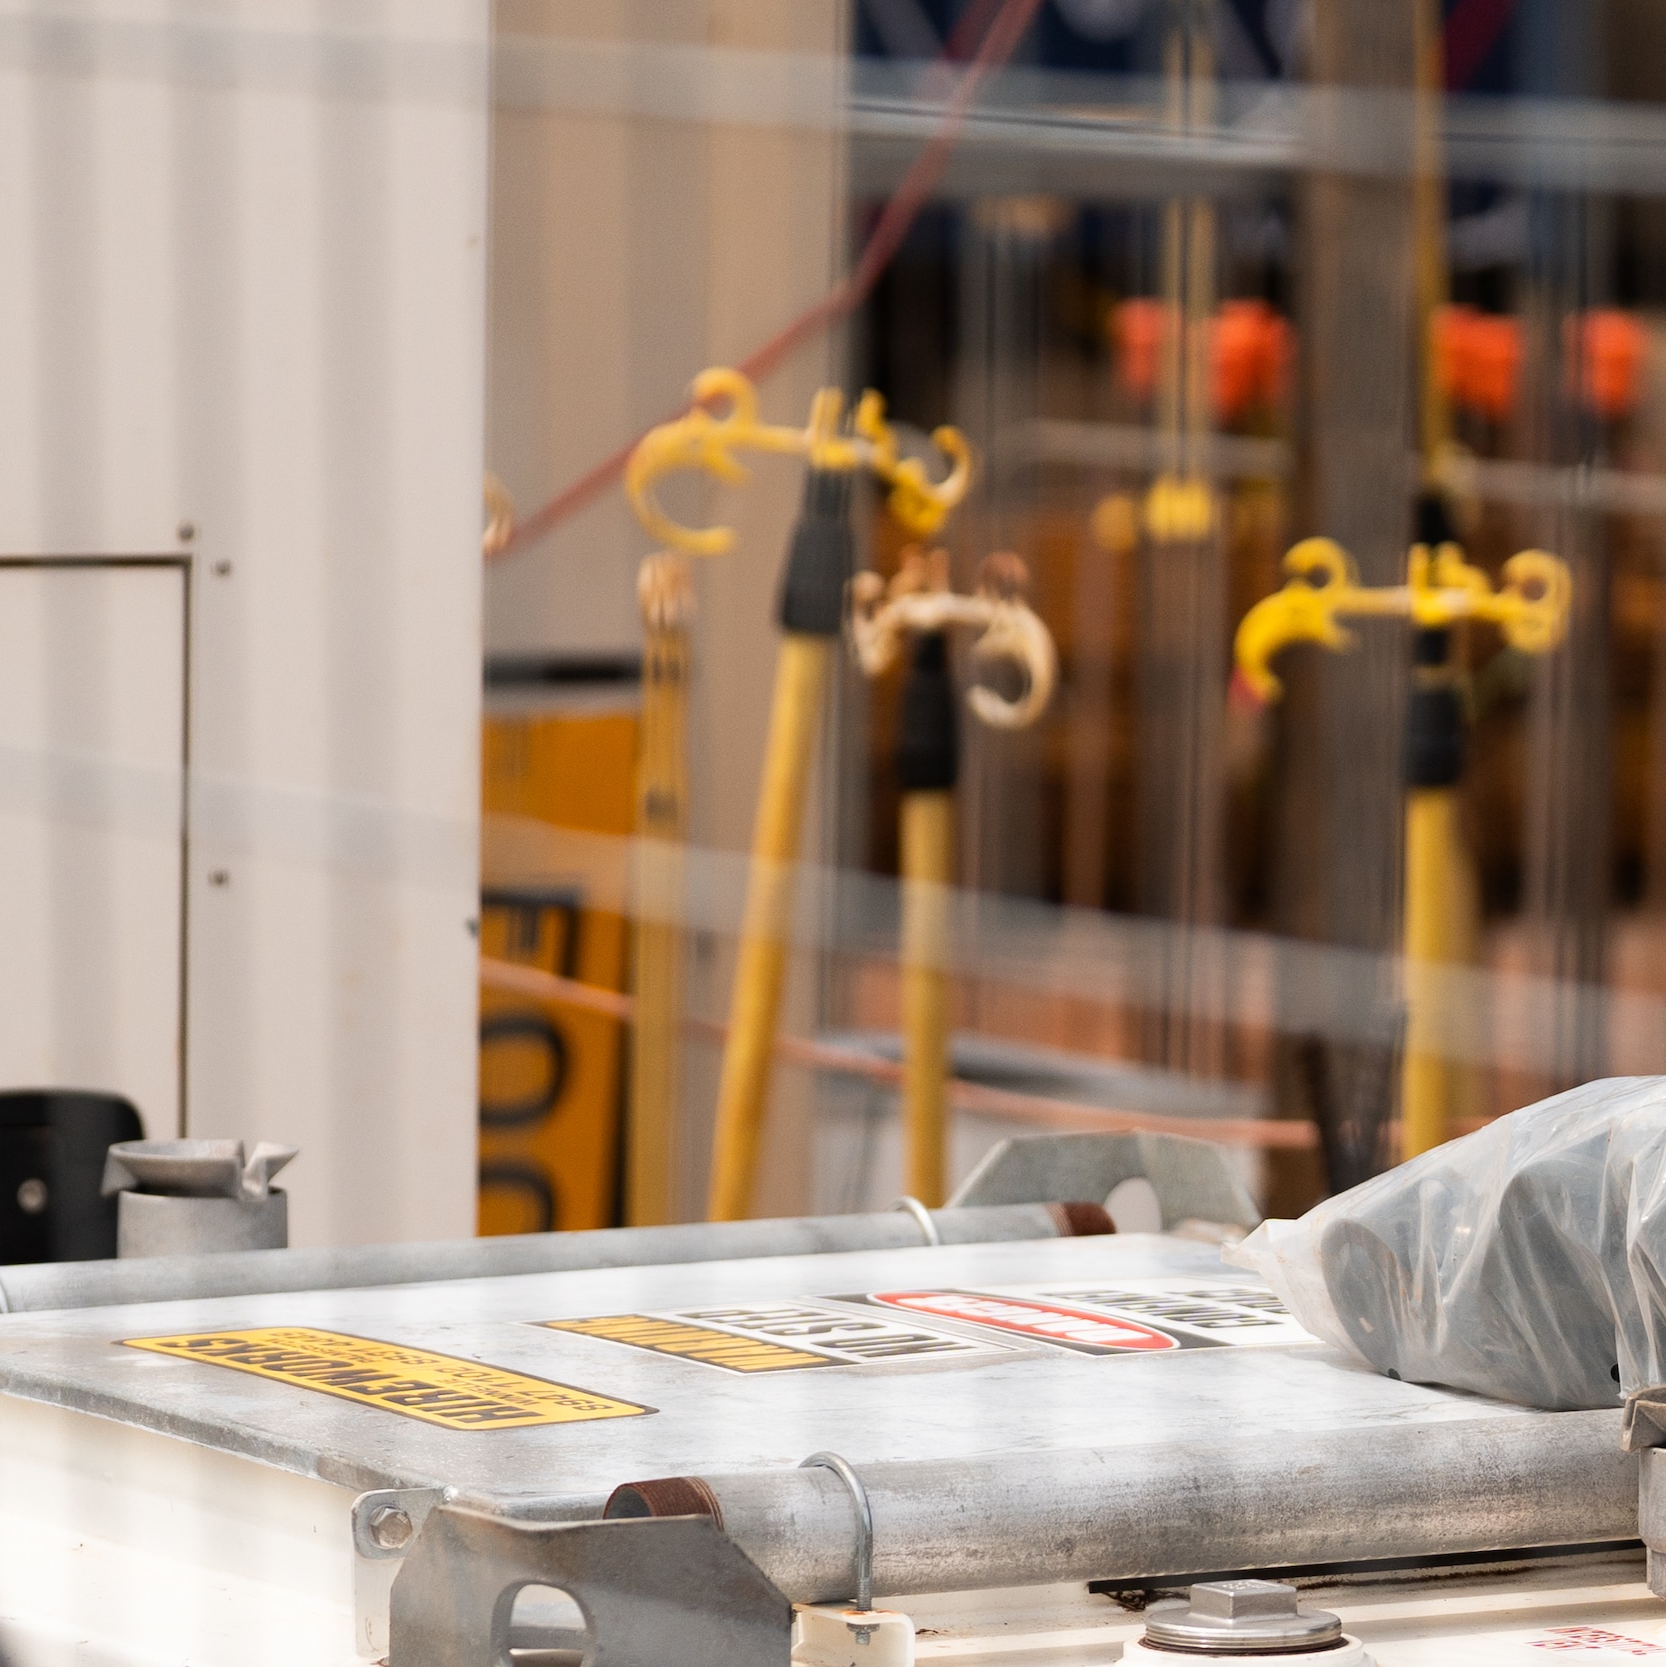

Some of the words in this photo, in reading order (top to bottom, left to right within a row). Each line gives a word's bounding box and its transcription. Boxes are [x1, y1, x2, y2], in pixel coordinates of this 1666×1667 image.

[675, 1308, 887, 1337] STEP
[896, 1296, 1152, 1342] DANGER
[543, 1315, 831, 1371] WARNING
[810, 1333, 978, 1358] NO
[156, 1338, 546, 1423] HIREWORKS
